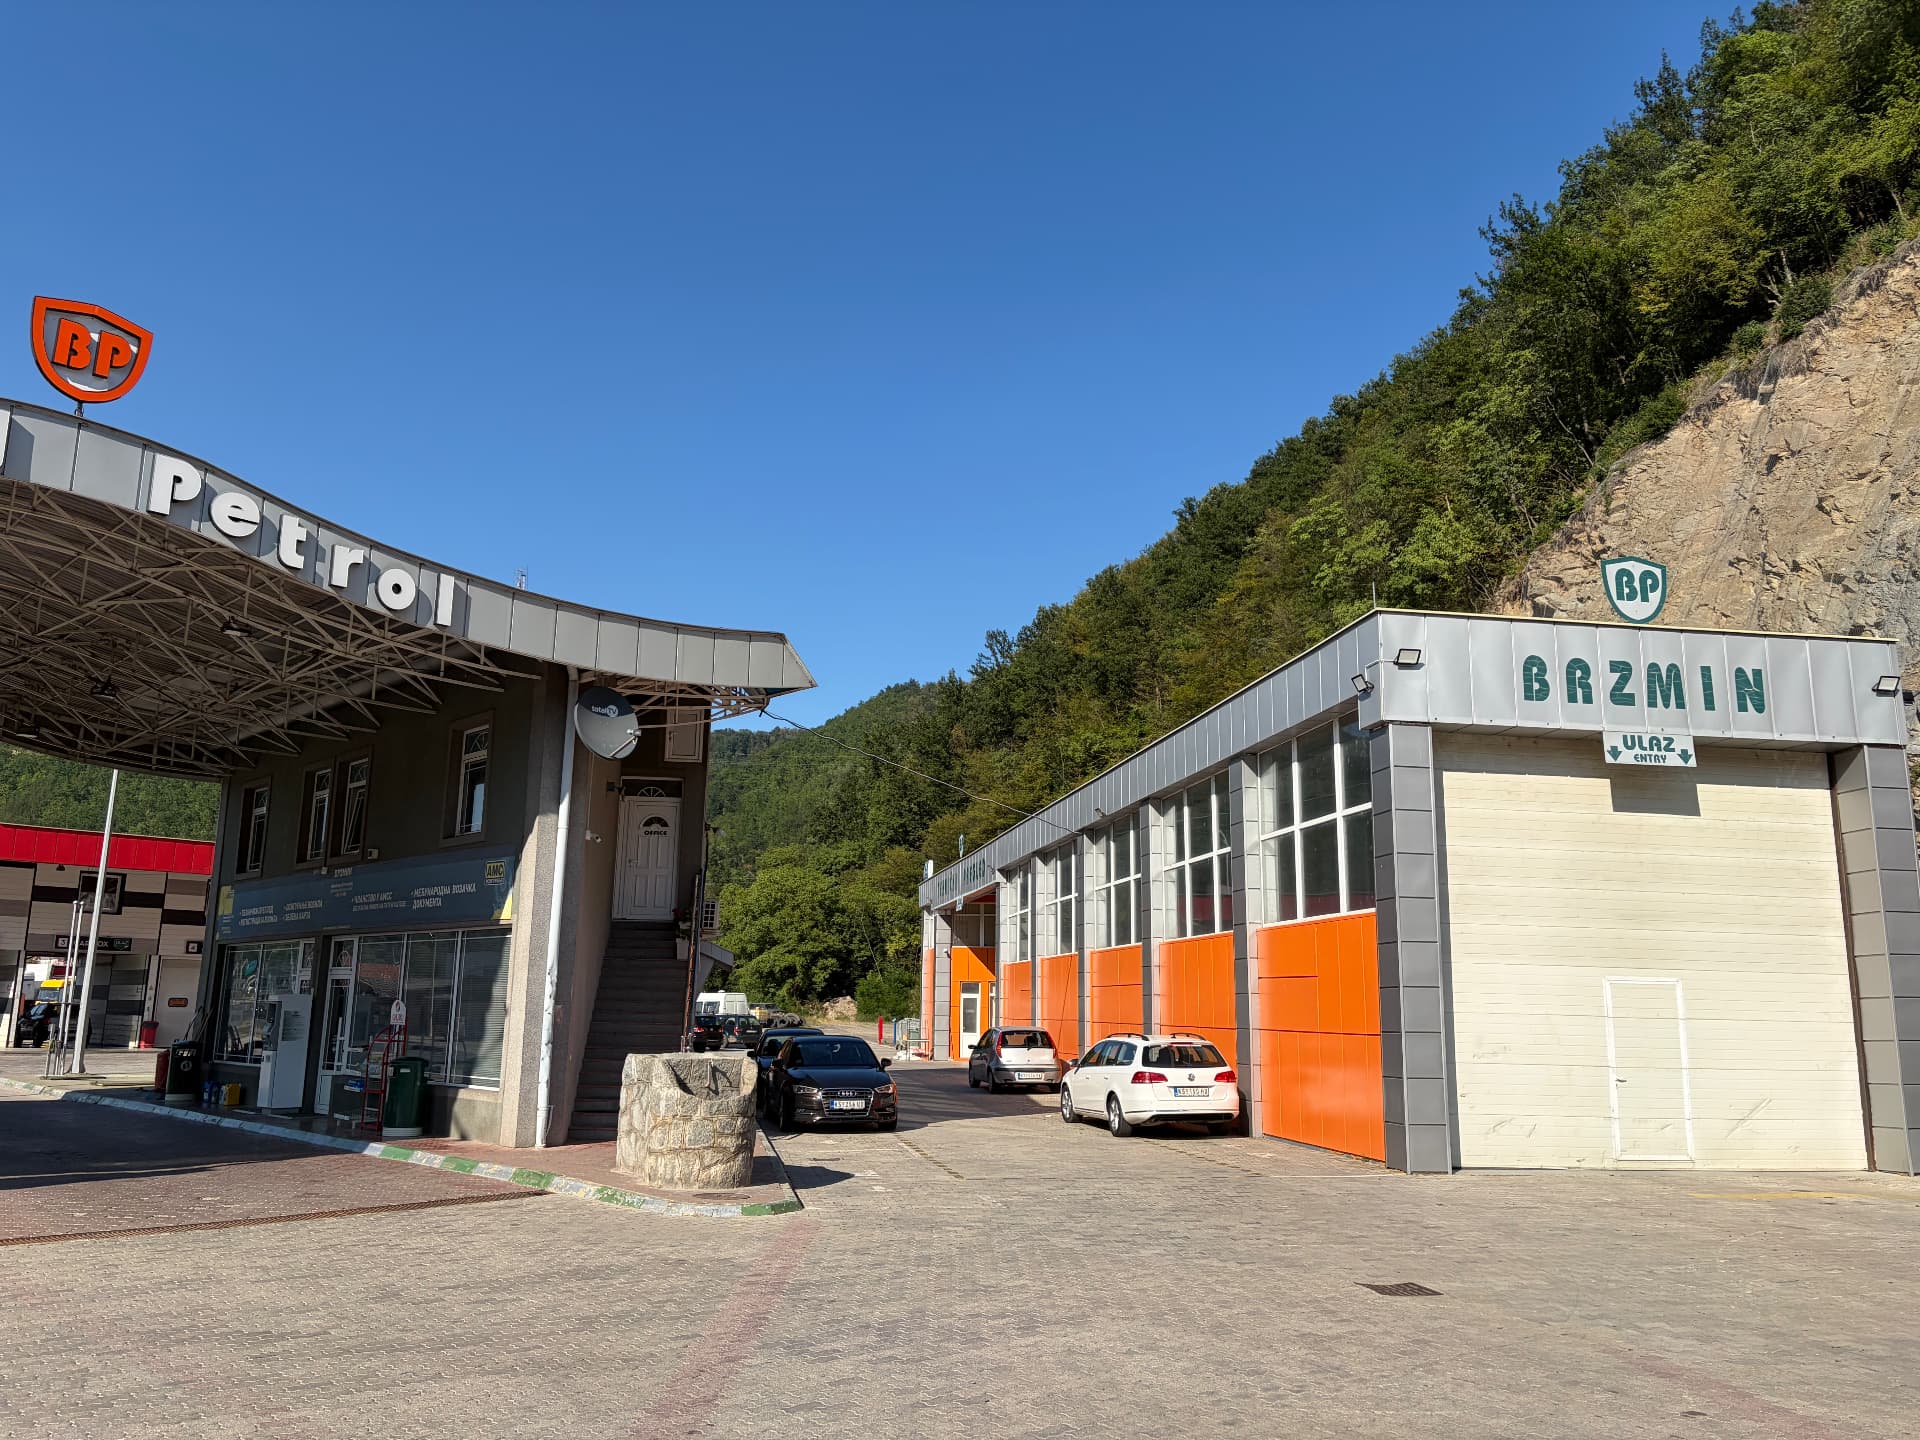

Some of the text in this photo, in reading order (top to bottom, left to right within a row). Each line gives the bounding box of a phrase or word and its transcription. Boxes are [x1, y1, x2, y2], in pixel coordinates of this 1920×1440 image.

[53, 318, 133, 378] BP
[146, 454, 456, 626] Petrol
[1615, 568, 1660, 603] BP
[1522, 655, 1766, 714] BRZMIN
[1622, 734, 1676, 753] ULAZ
[1633, 753, 1667, 764] ENTRY
